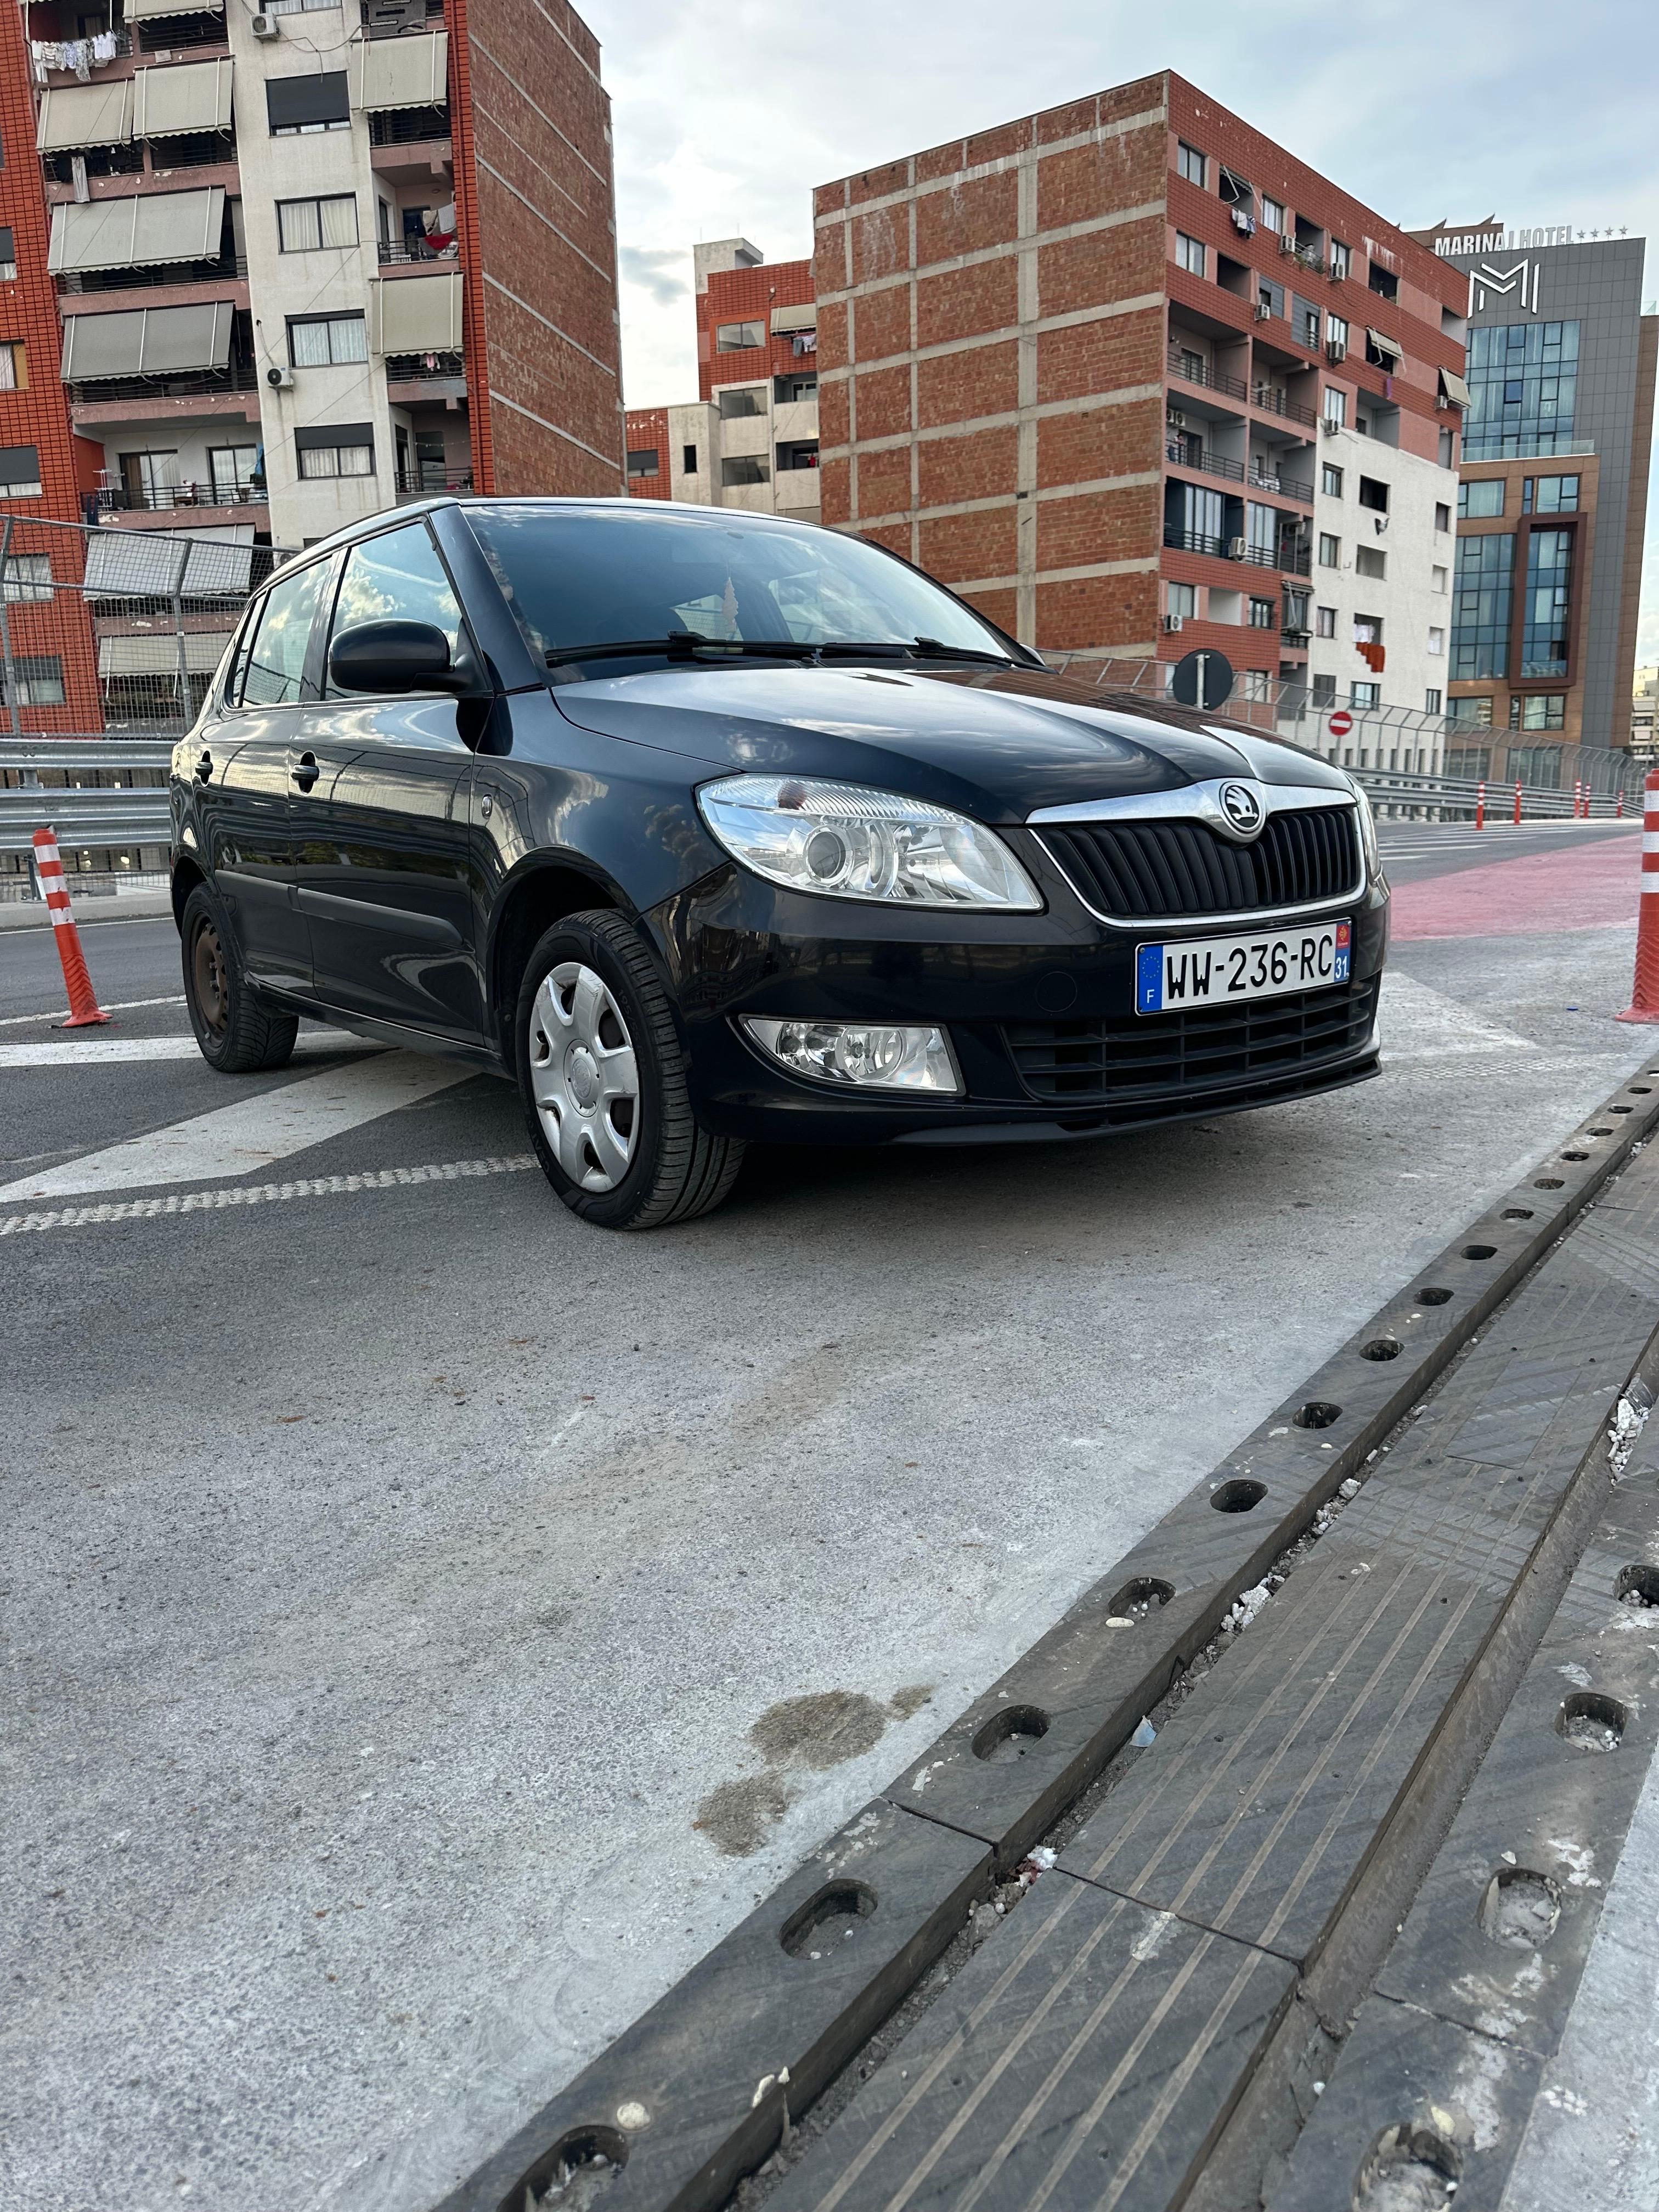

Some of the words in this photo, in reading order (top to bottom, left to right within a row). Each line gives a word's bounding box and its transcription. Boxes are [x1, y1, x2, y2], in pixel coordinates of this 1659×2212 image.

[1435, 230, 1514, 256] MARINAJ
[1520, 225, 1574, 249] HOTEL
[1166, 933, 1333, 1000] WW-236-RC
[1335, 955, 1347, 979] 31
[1147, 989, 1155, 1003] F
